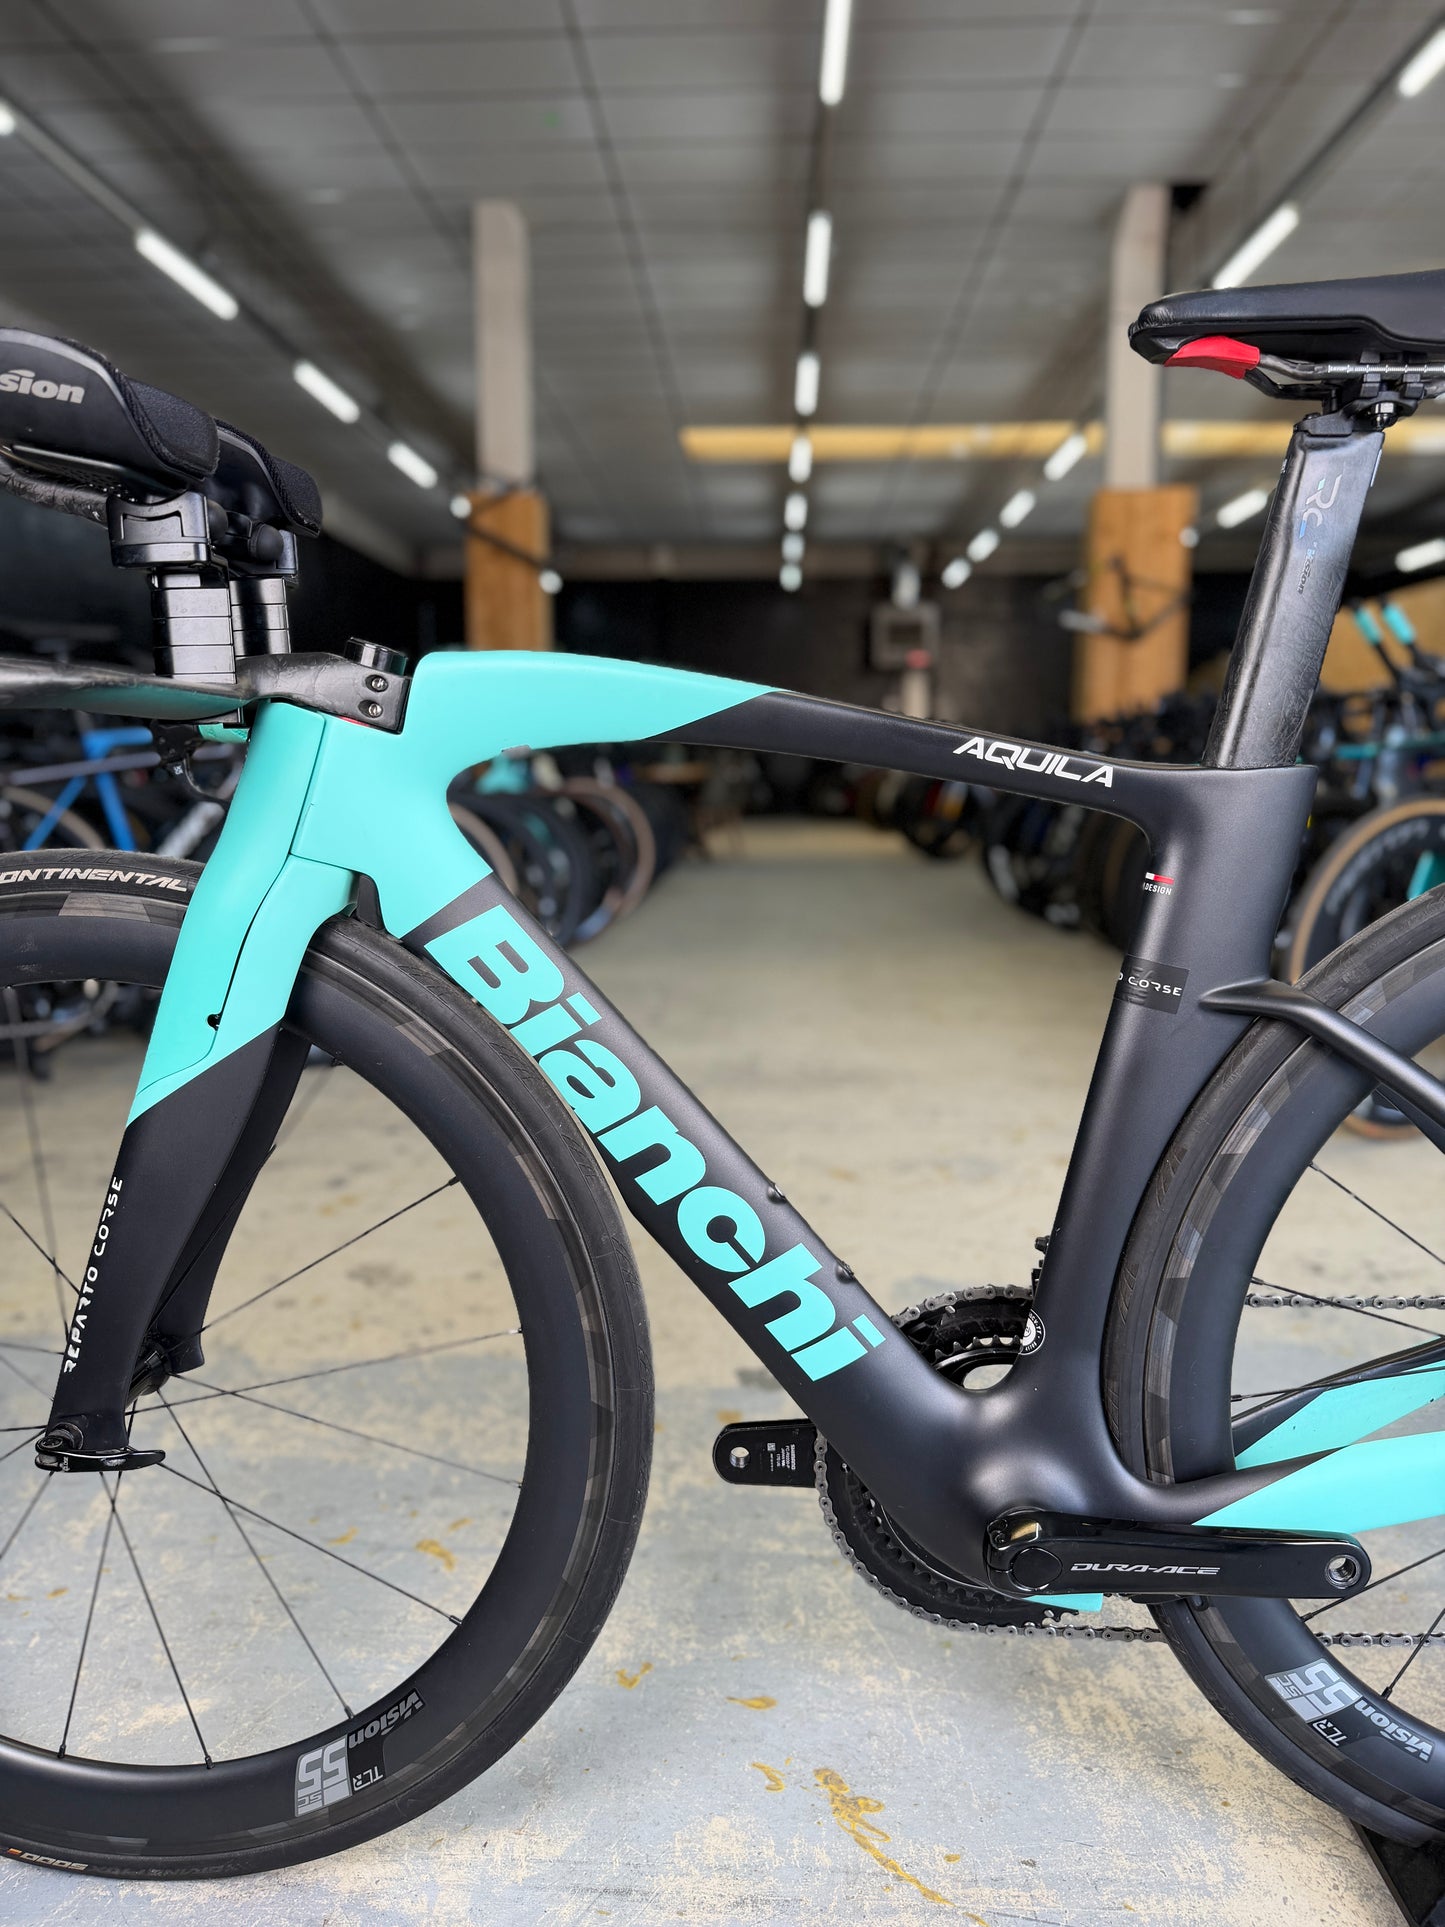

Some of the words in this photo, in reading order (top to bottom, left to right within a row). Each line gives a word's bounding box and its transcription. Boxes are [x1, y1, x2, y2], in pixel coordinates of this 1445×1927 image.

[953, 736, 1114, 788] AQUILA
[1128, 976, 1182, 996] CORSE
[423, 904, 886, 1382] Bianchi
[63, 1261, 100, 1374] REPARTO
[94, 1177, 124, 1256] CORSE
[1071, 1562, 1220, 1575] DURA-ACE
[1289, 1662, 1360, 1715] 55
[1312, 1718, 1348, 1747] TLR
[298, 1738, 347, 1798] 55
[352, 1765, 384, 1792] TLR
[19, 1852, 89, 1871] 5000
